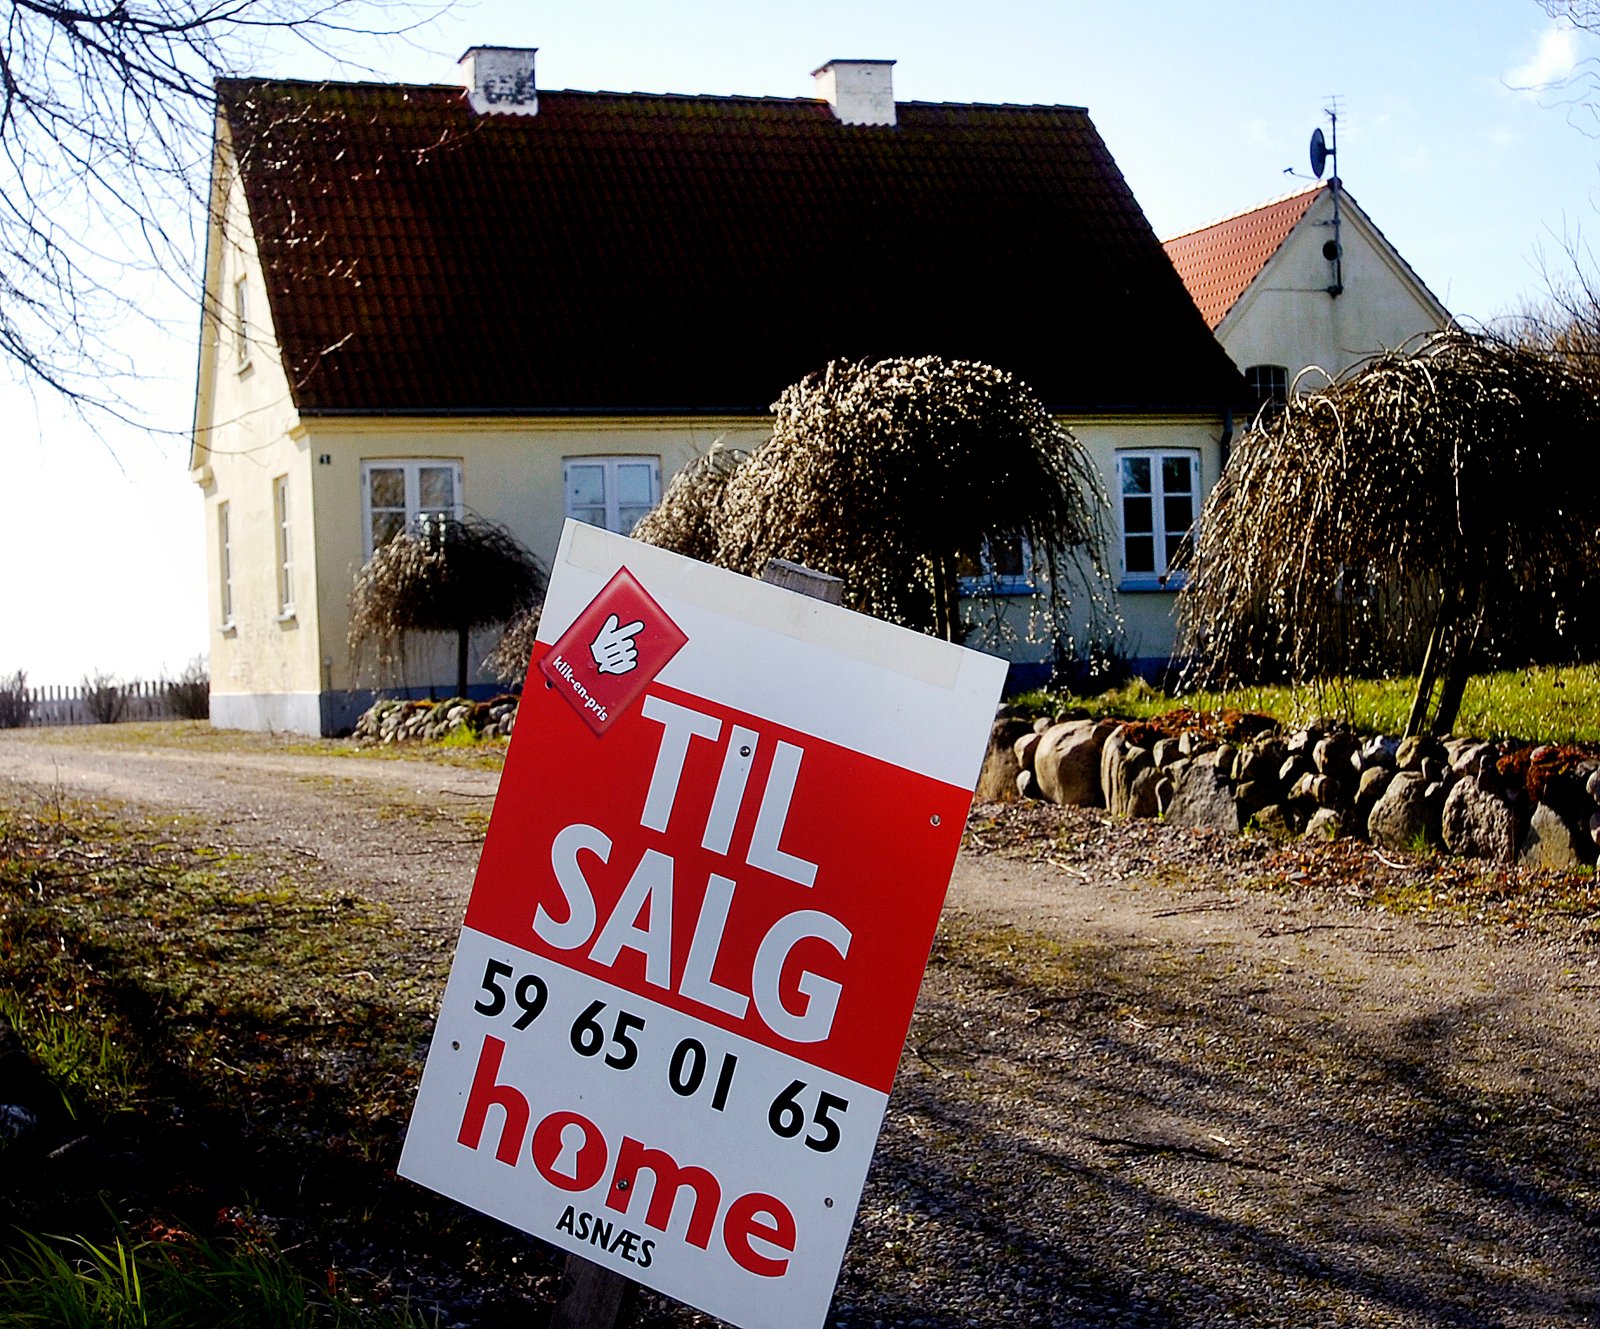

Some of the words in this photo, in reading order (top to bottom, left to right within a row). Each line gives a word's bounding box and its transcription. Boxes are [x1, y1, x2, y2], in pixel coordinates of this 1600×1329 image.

[552, 656, 608, 721] klik-en-pris
[640, 694, 819, 889] TIL
[531, 823, 853, 1043] SALG
[474, 958, 548, 1031] 59
[570, 999, 646, 1071] 65
[668, 1037, 738, 1112] 01
[768, 1079, 849, 1153] 65
[458, 1034, 797, 1277] home
[555, 1205, 656, 1268] ASNÆS
